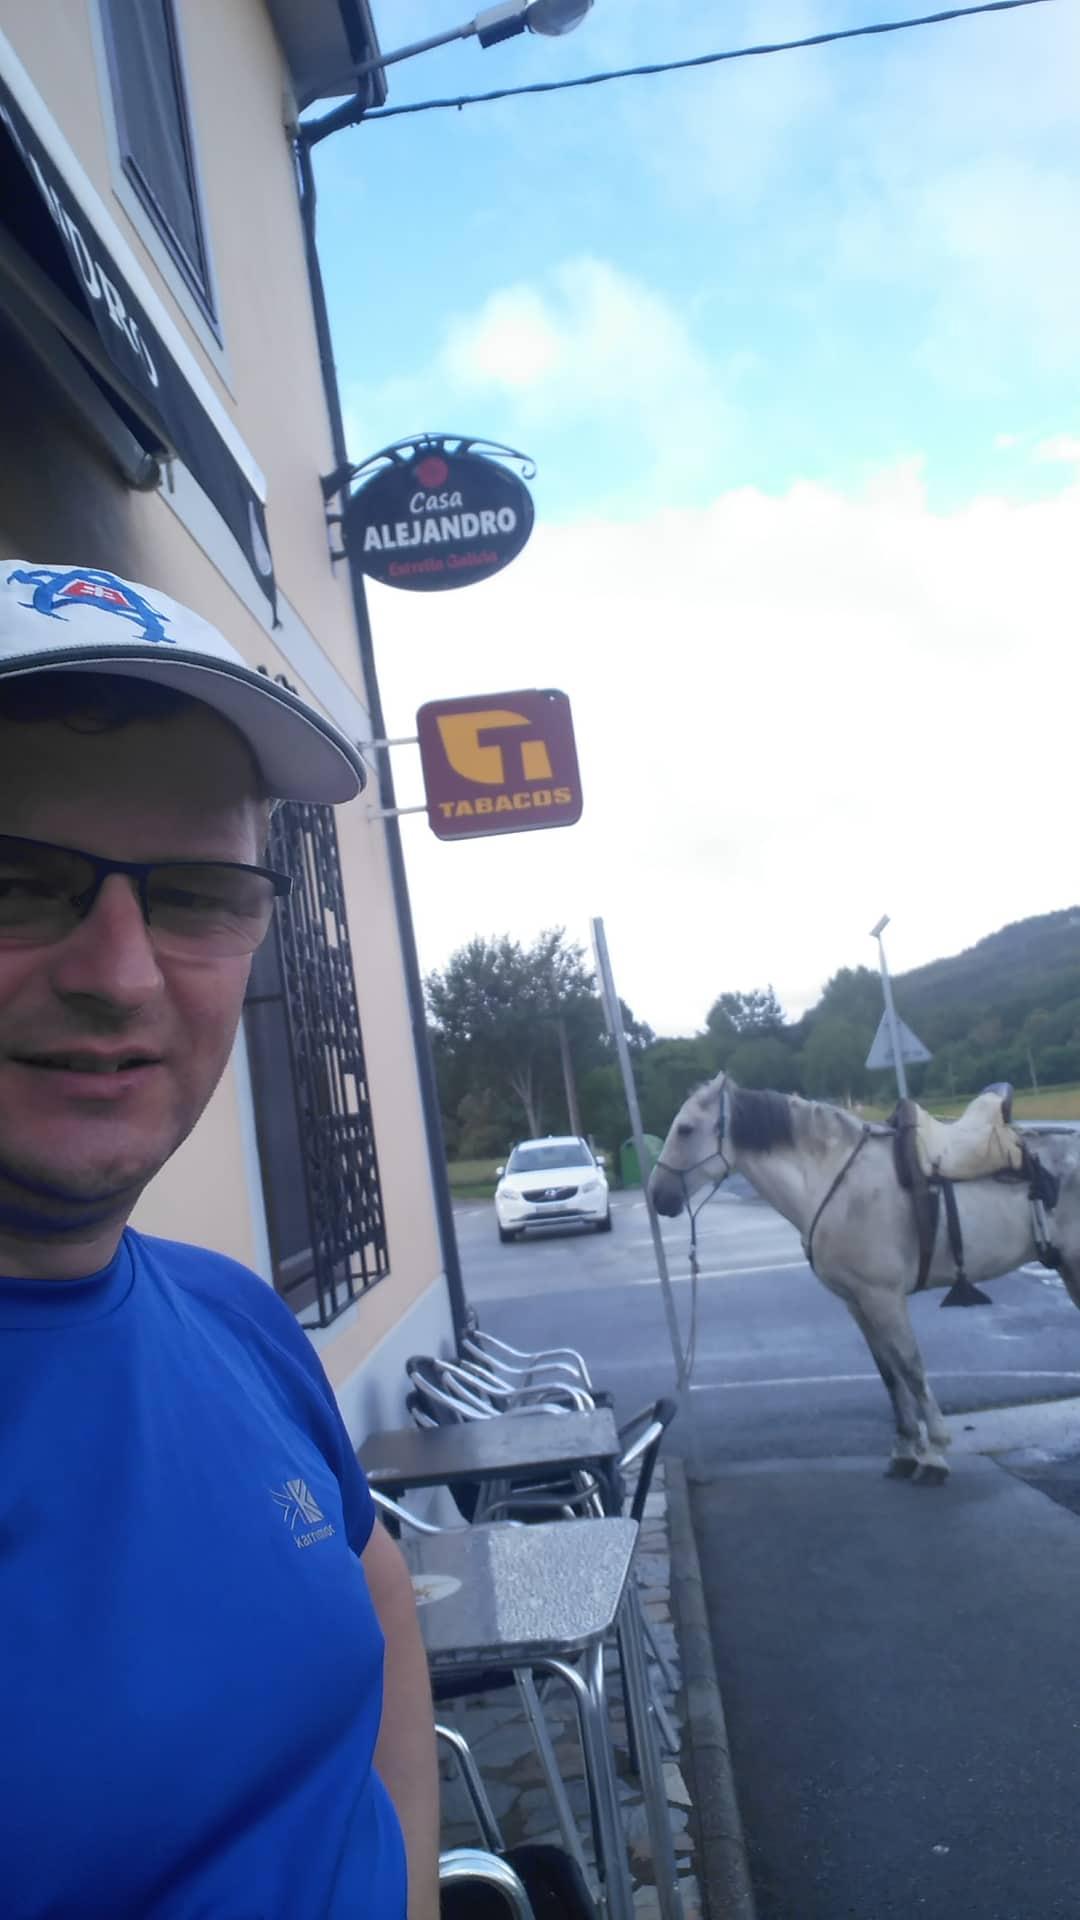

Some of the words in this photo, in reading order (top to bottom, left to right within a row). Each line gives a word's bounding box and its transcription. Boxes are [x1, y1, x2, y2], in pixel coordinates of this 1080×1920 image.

[409, 490, 463, 514] Casa
[363, 506, 517, 552] ALEJANDRO
[439, 786, 573, 819] TABACOS
